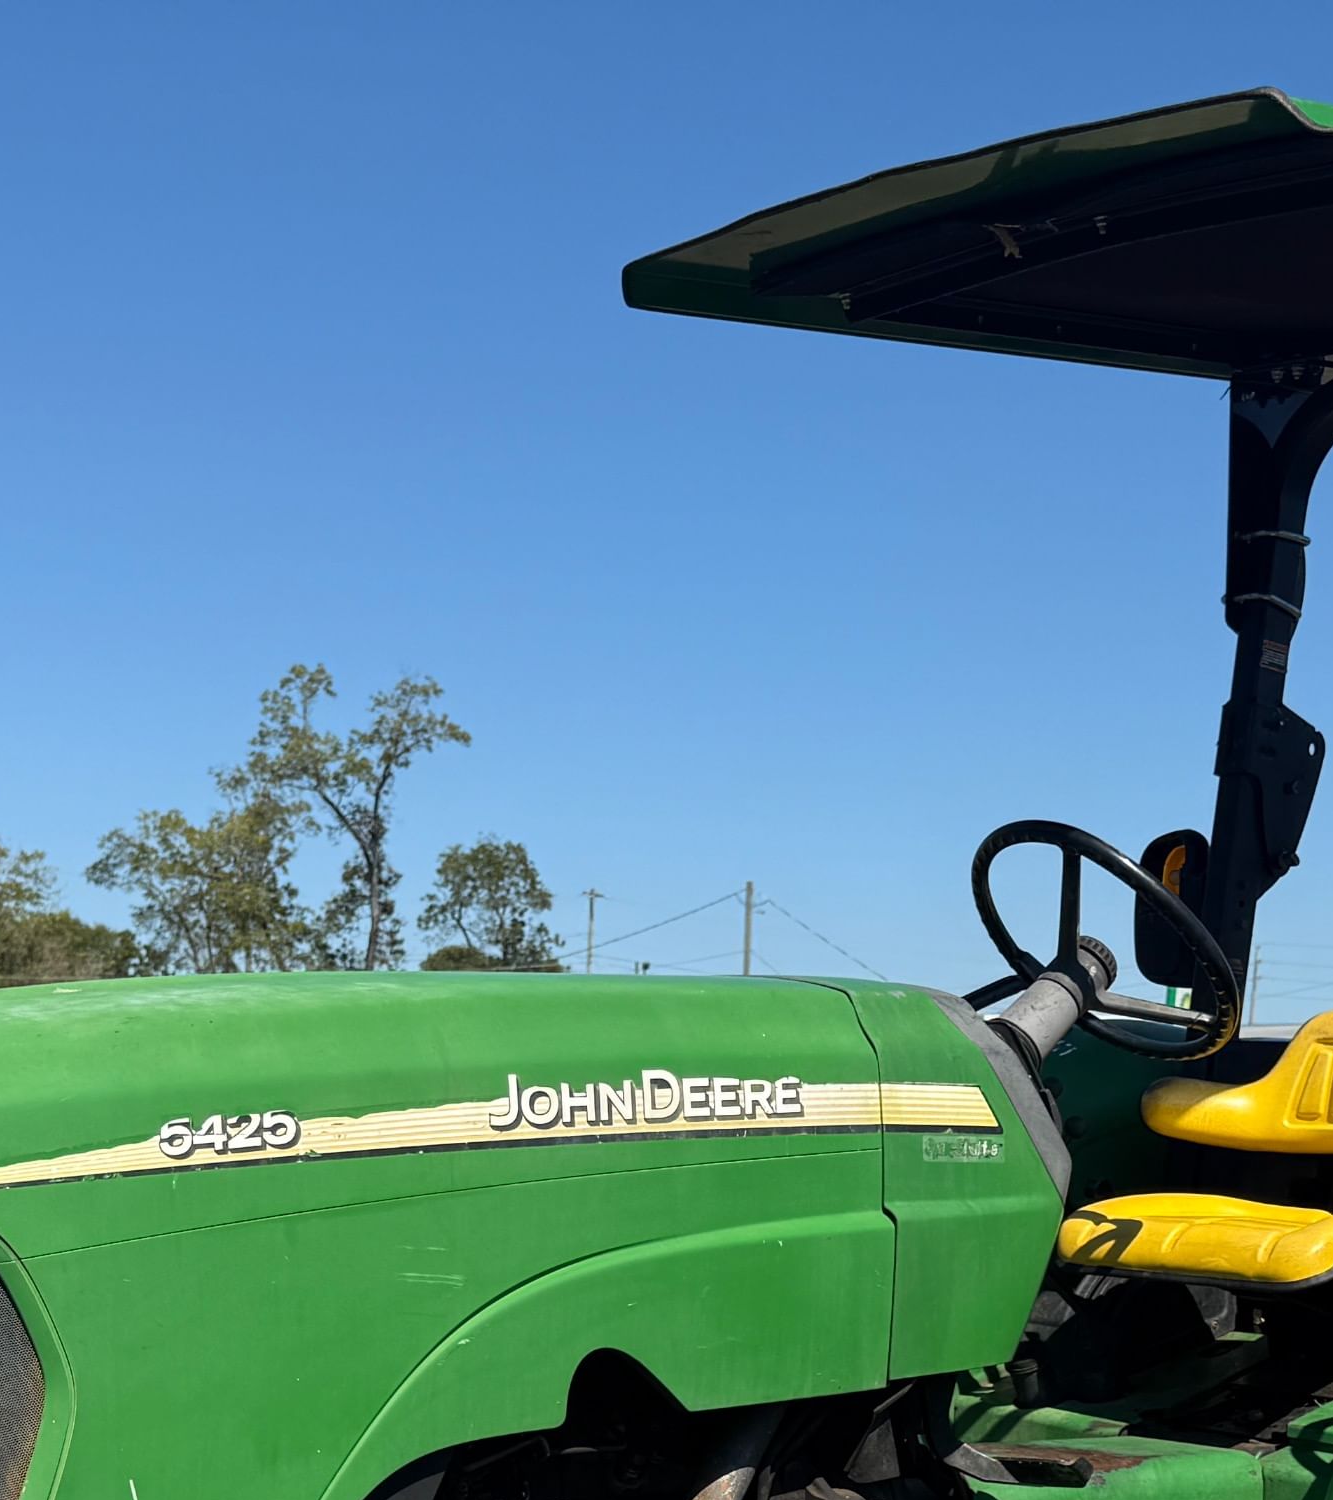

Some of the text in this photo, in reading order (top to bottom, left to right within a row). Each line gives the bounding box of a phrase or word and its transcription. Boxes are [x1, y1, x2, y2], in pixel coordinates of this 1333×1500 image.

[489, 1069, 804, 1131] JOHN DEERE
[159, 1109, 301, 1159] 5425
